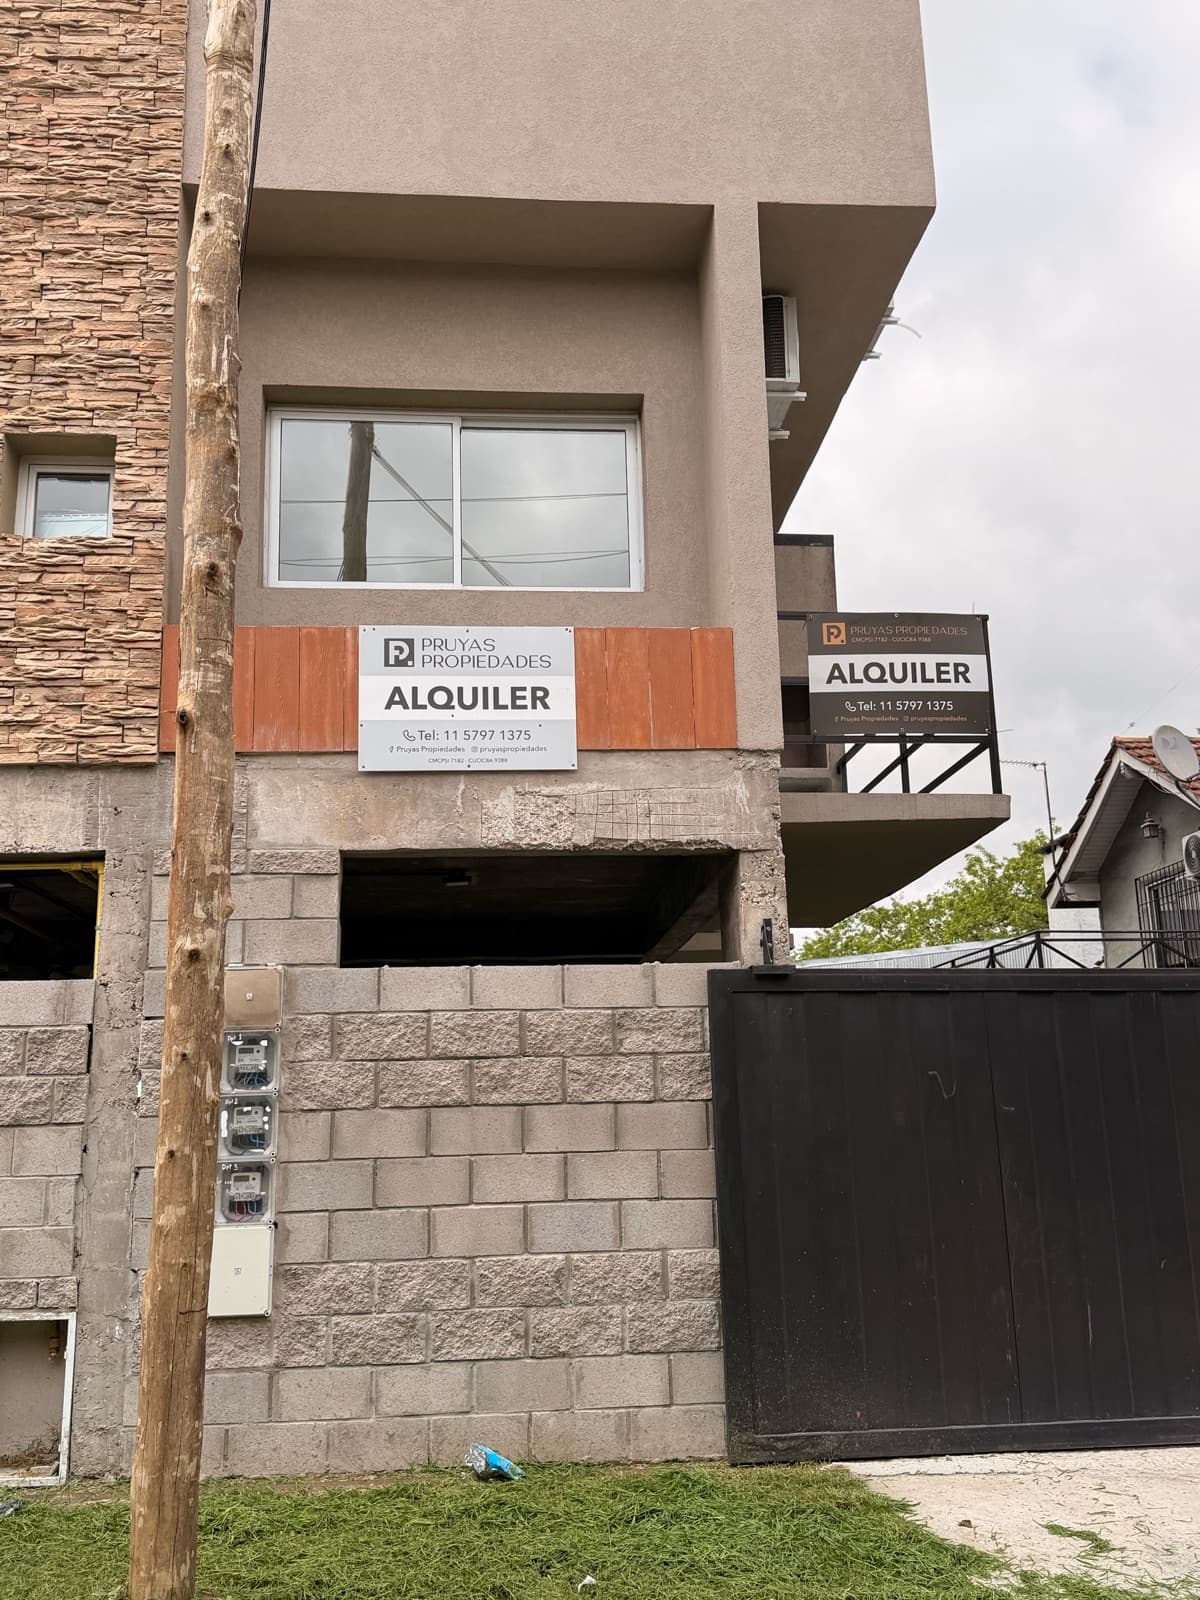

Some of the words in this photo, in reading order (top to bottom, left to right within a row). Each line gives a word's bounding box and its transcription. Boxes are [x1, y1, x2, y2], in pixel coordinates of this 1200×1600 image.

[850, 625, 894, 635] PRUYAS
[895, 625, 968, 636] PROPIEDADES
[422, 638, 496, 652] PRUYAS
[421, 654, 552, 669] PROPIEDADES
[826, 661, 972, 685] ALQUILER
[384, 685, 551, 711] ALQUILER
[857, 700, 877, 711] Tel:
[879, 701, 892, 711] 11
[896, 700, 923, 711] 5797
[926, 700, 954, 711] 1375
[417, 729, 440, 741] Tel:
[444, 729, 459, 741] 11
[463, 729, 496, 741] 5797
[499, 729, 532, 741] 1375
[396, 745, 420, 754] Pruyas
[421, 745, 466, 754] Propiedades
[479, 745, 548, 754] pruyaspropiedades
